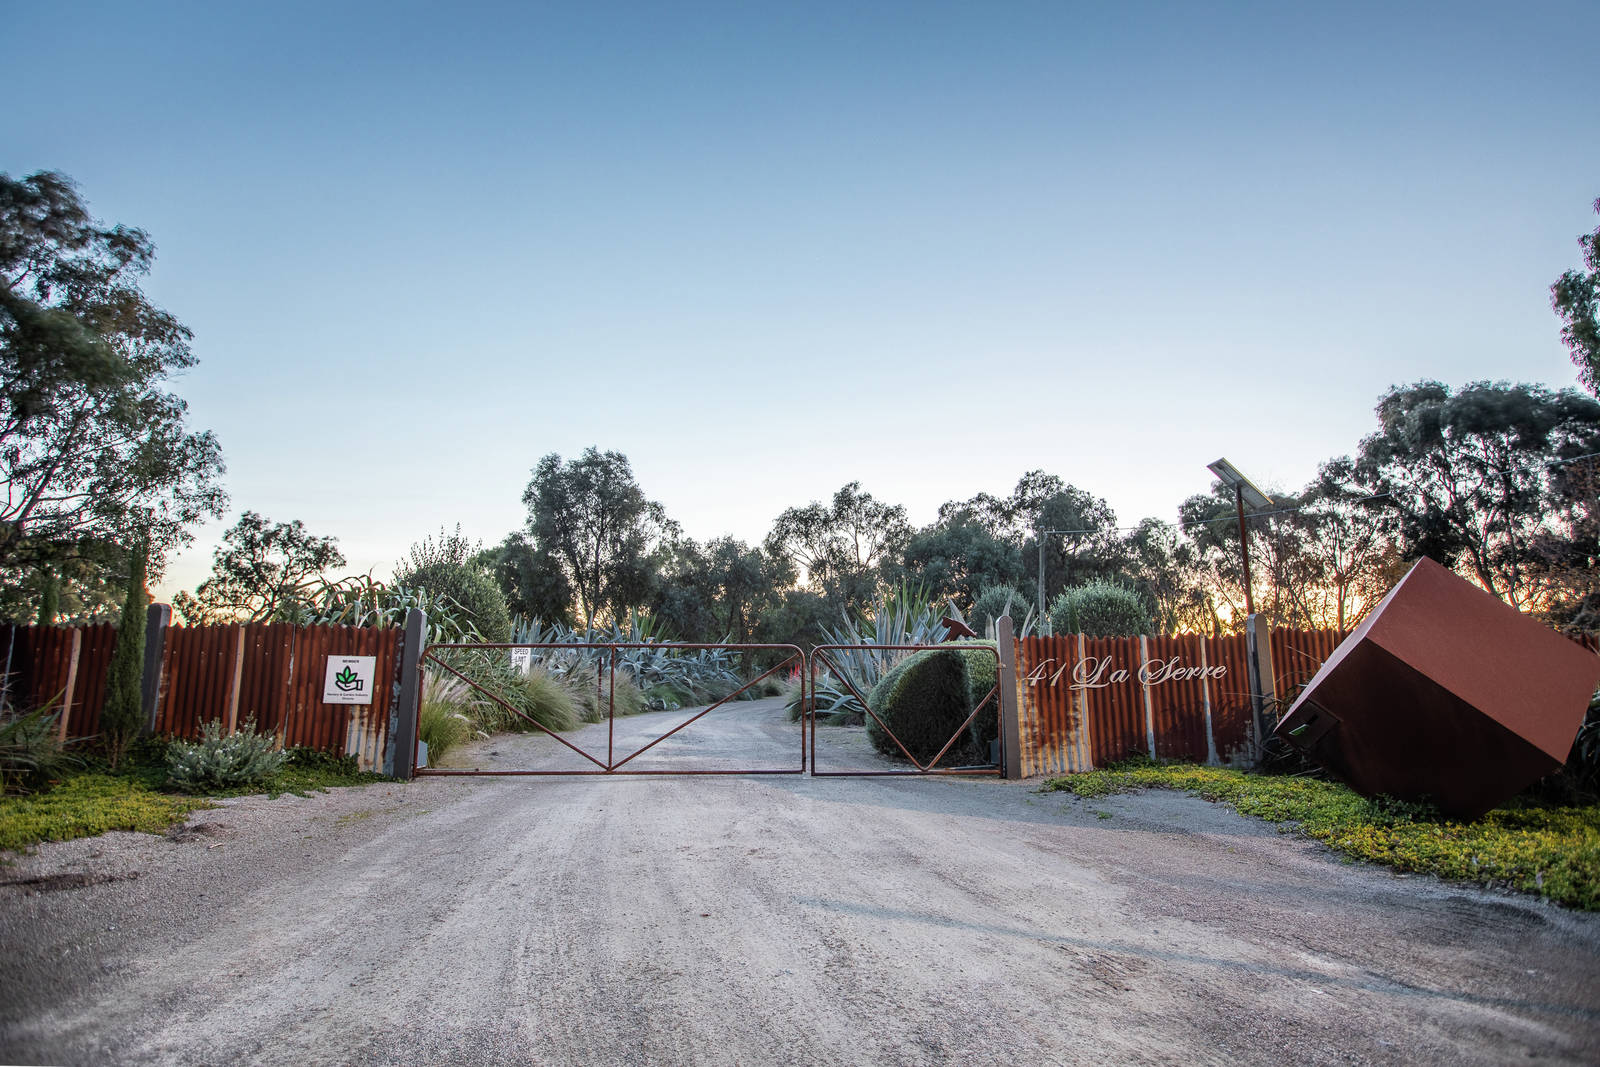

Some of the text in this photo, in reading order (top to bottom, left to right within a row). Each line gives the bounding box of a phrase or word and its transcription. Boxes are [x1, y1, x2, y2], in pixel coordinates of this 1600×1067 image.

[1022, 655, 1227, 690] 41 La Serre
